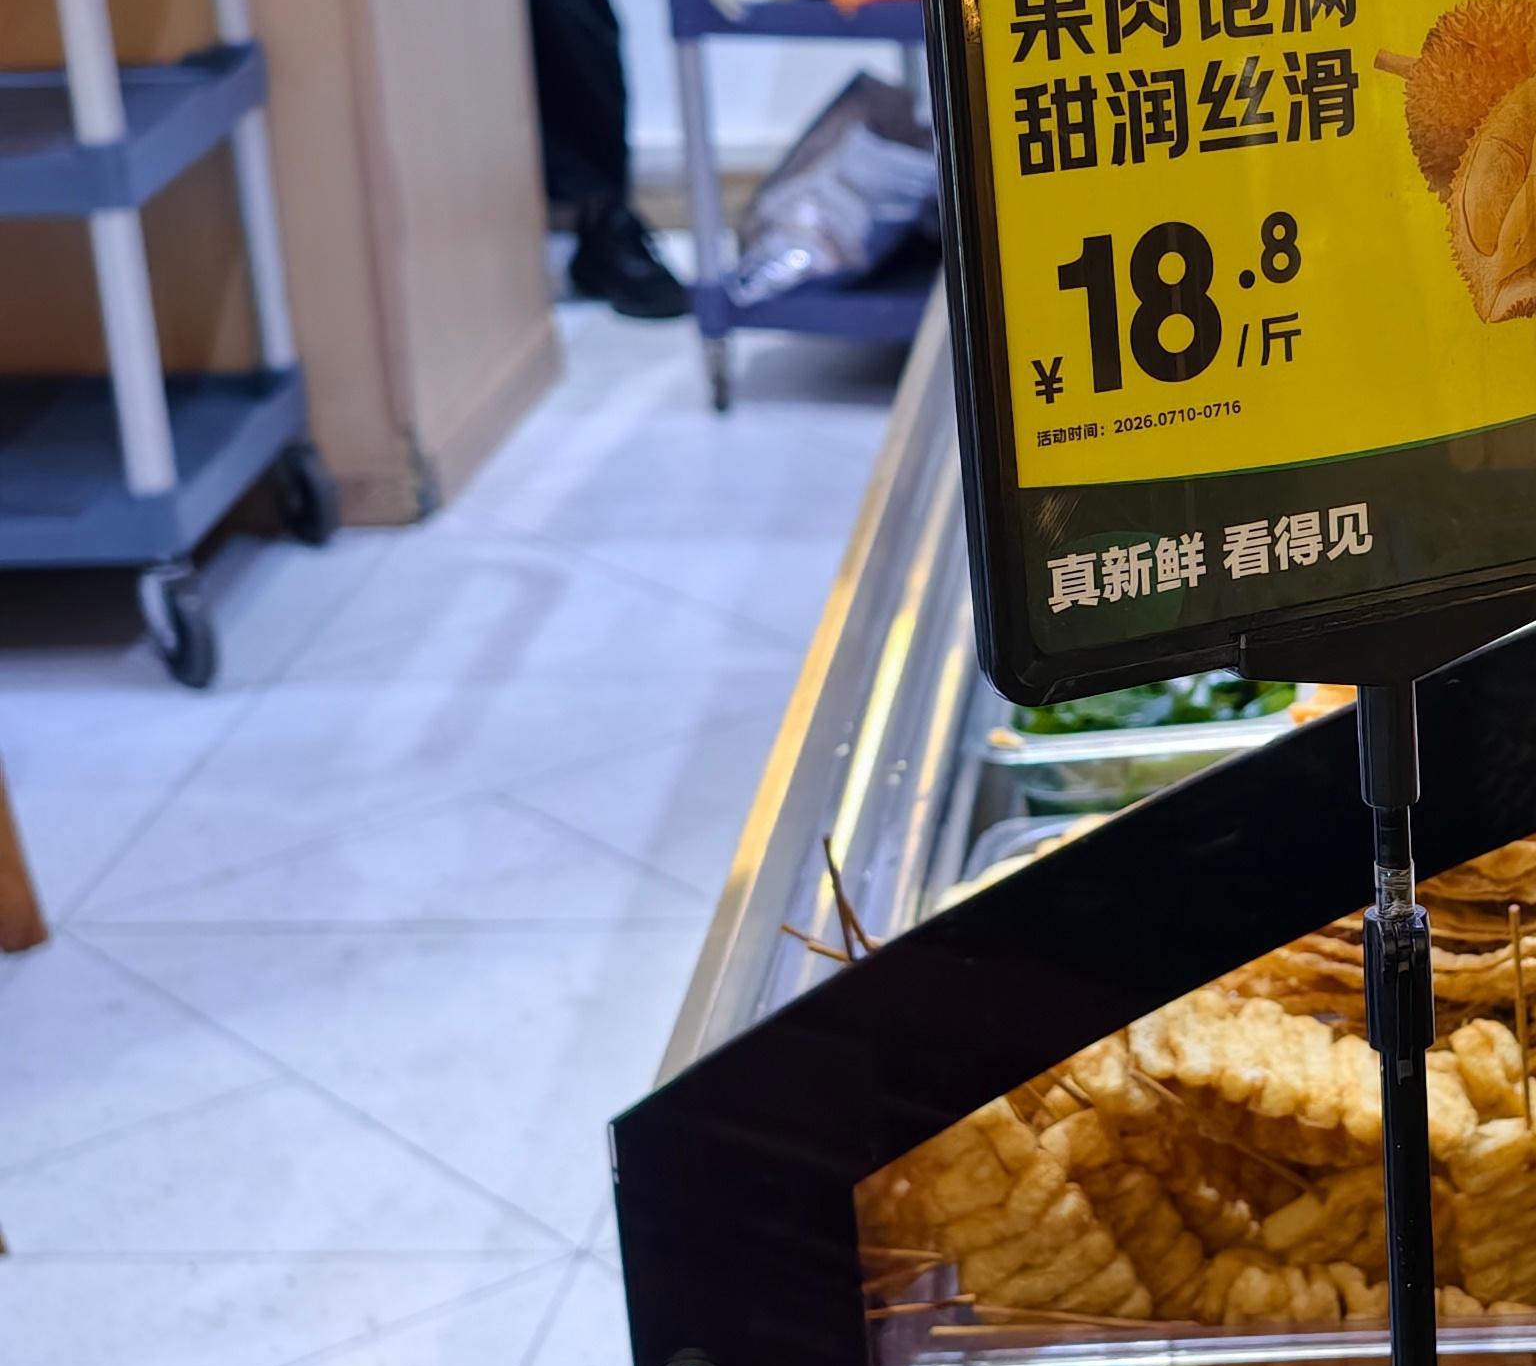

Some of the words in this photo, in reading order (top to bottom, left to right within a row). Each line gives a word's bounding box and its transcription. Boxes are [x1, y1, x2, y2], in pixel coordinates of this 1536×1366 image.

[1013, 48, 1359, 176] 甜润丝滑
[1046, 531, 1207, 614] 真新鲜
[1222, 503, 1373, 580] 看得见
